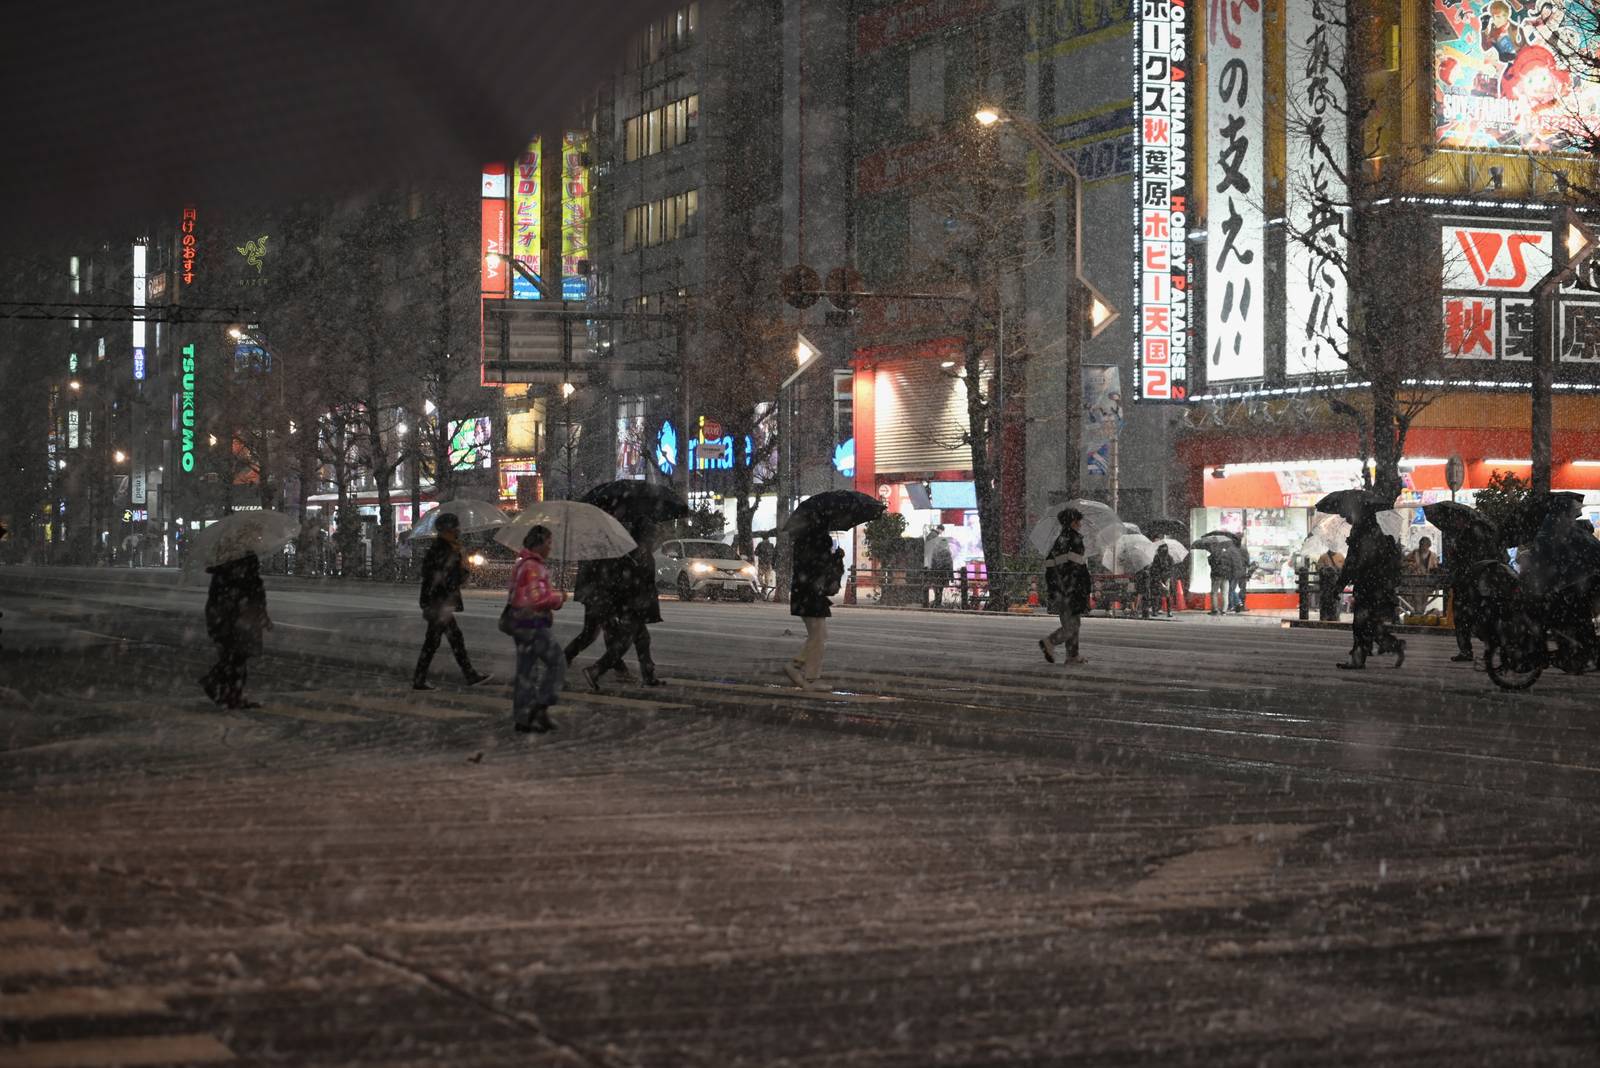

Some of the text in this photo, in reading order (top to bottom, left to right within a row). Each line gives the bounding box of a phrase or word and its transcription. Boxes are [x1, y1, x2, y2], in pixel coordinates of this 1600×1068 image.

[1170, 66, 1186, 191] AKIHABARA
[1171, 195, 1187, 271] HOBBY
[1171, 275, 1187, 381] PARADISE
[182, 343, 195, 473] TSUKUMO
[1171, 386, 1187, 399] 2
